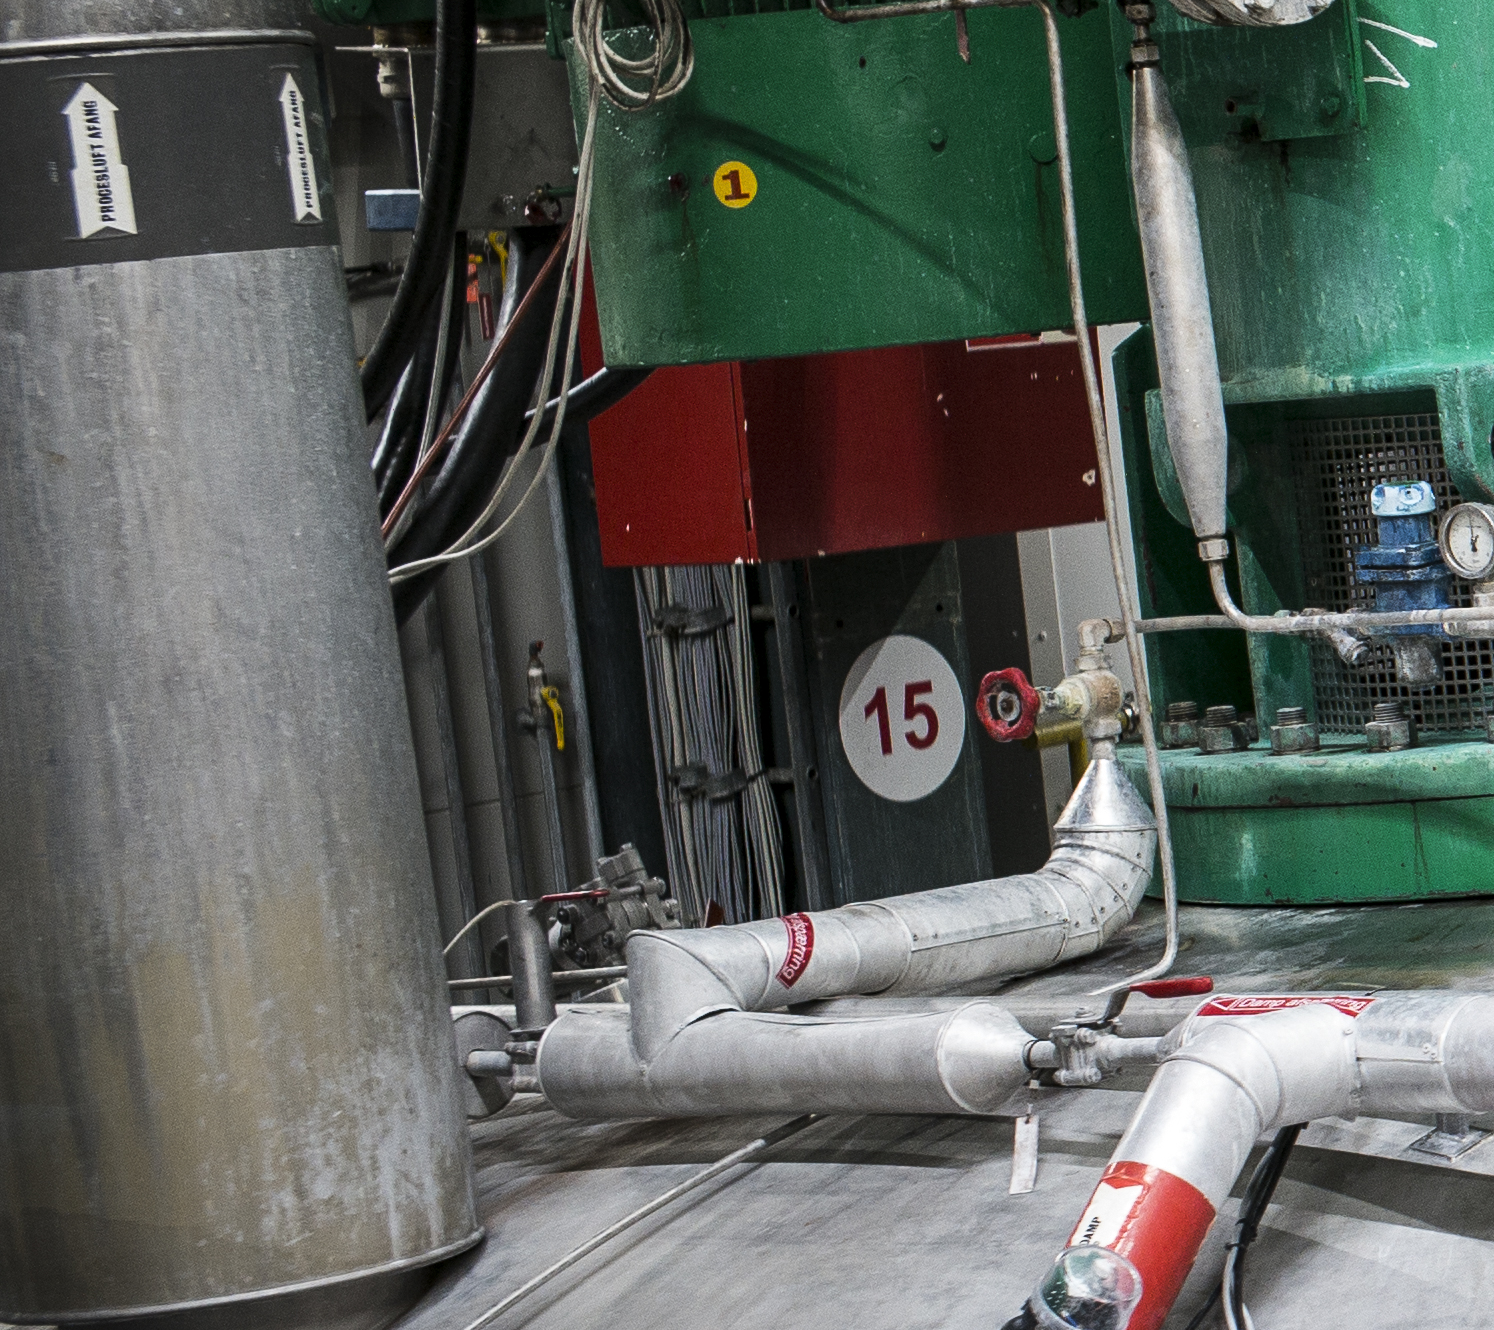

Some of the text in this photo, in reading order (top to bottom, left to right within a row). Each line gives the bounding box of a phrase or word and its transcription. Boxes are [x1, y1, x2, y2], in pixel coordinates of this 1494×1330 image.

[82, 100, 116, 223] PROCESLUFT AFANG
[721, 171, 751, 201] 1
[862, 679, 938, 757] 15
[1238, 998, 1286, 1008] Damp
[1080, 1216, 1102, 1246] DAMP
